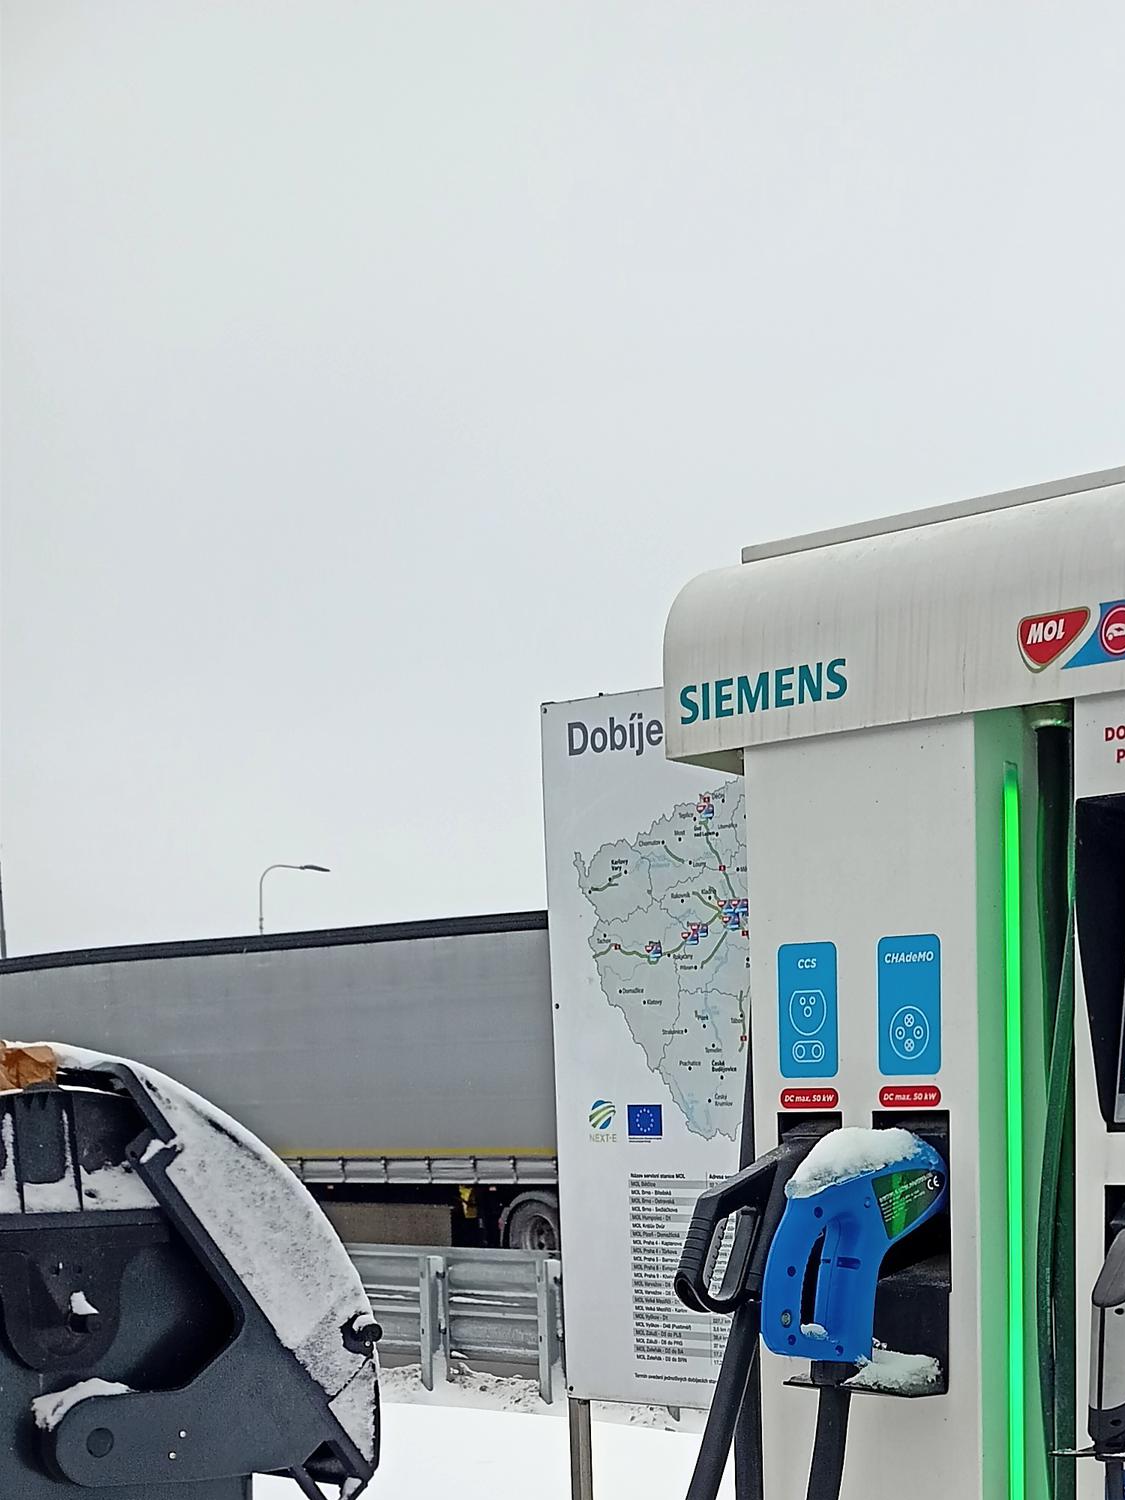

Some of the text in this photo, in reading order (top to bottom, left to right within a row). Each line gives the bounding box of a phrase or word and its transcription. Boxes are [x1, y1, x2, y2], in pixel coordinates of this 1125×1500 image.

[1026, 617, 1068, 645] MOL
[679, 656, 849, 725] SIEMENS
[567, 711, 664, 757] Dobíje
[797, 958, 817, 969] CCS
[884, 950, 934, 964] CHAdeMO
[784, 1094, 835, 1103] DC max. 50 kW
[883, 1092, 937, 1101] DC max. 50 kW
